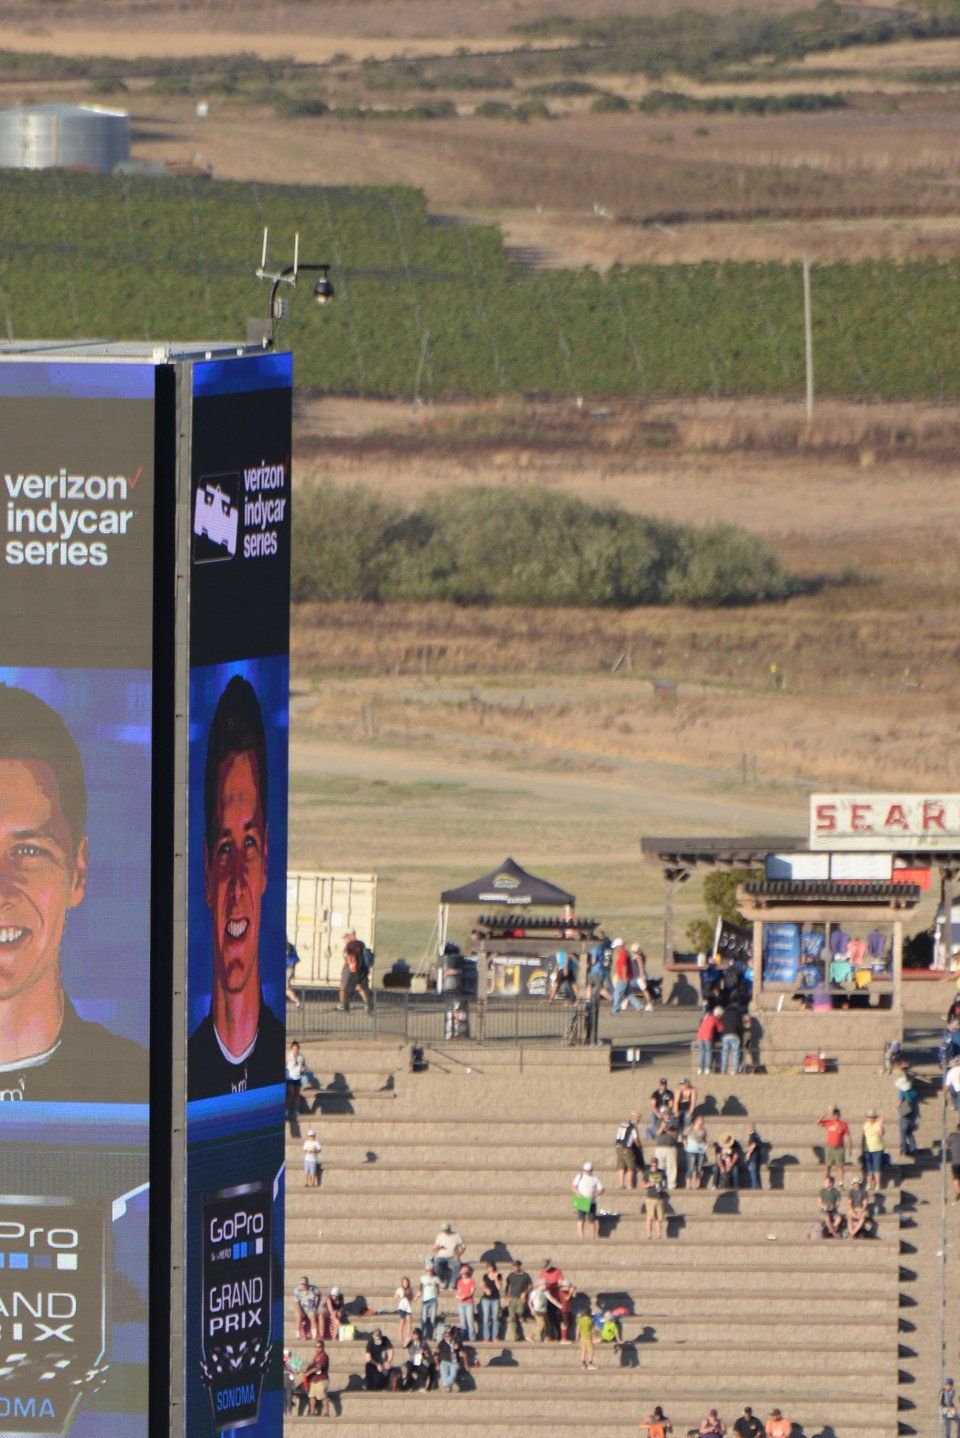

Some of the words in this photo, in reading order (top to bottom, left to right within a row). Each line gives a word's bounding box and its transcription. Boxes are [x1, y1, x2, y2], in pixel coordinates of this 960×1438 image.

[4, 468, 128, 500] verizon
[243, 459, 284, 492] verizon
[6, 502, 133, 541] indycar
[244, 493, 286, 531] indycar
[4, 539, 108, 566] series
[243, 530, 278, 558] series
[210, 1211, 264, 1243] GoPro
[209, 1277, 263, 1313] GRAND
[209, 1308, 262, 1337] PRIX
[217, 1384, 256, 1412] SONOMA
